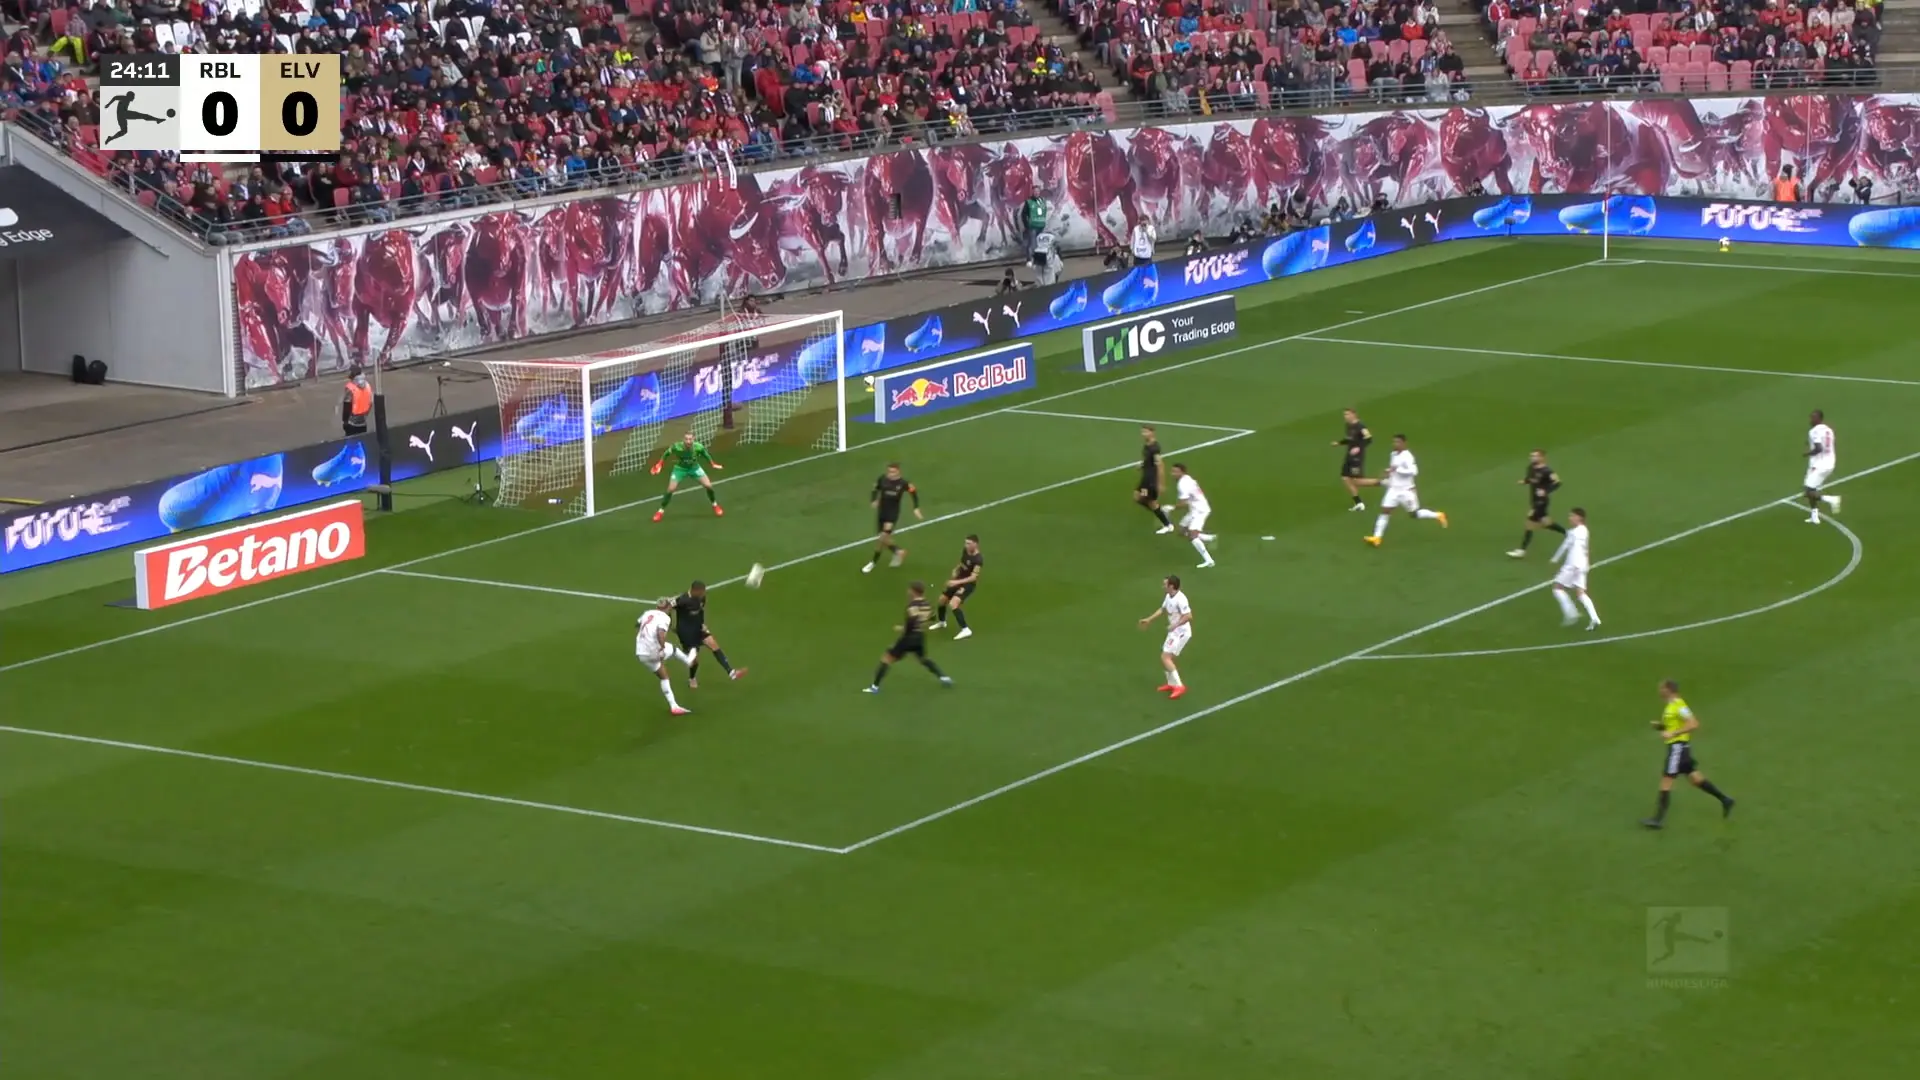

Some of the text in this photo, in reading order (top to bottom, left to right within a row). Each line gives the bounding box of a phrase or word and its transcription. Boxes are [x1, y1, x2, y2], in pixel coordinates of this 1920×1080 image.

[2, 229, 54, 243] Edge
[1171, 315, 1195, 329] Your
[1172, 320, 1236, 344] Trading Edge
[953, 356, 1027, 397] Red Bull
[163, 521, 350, 600] Betano
